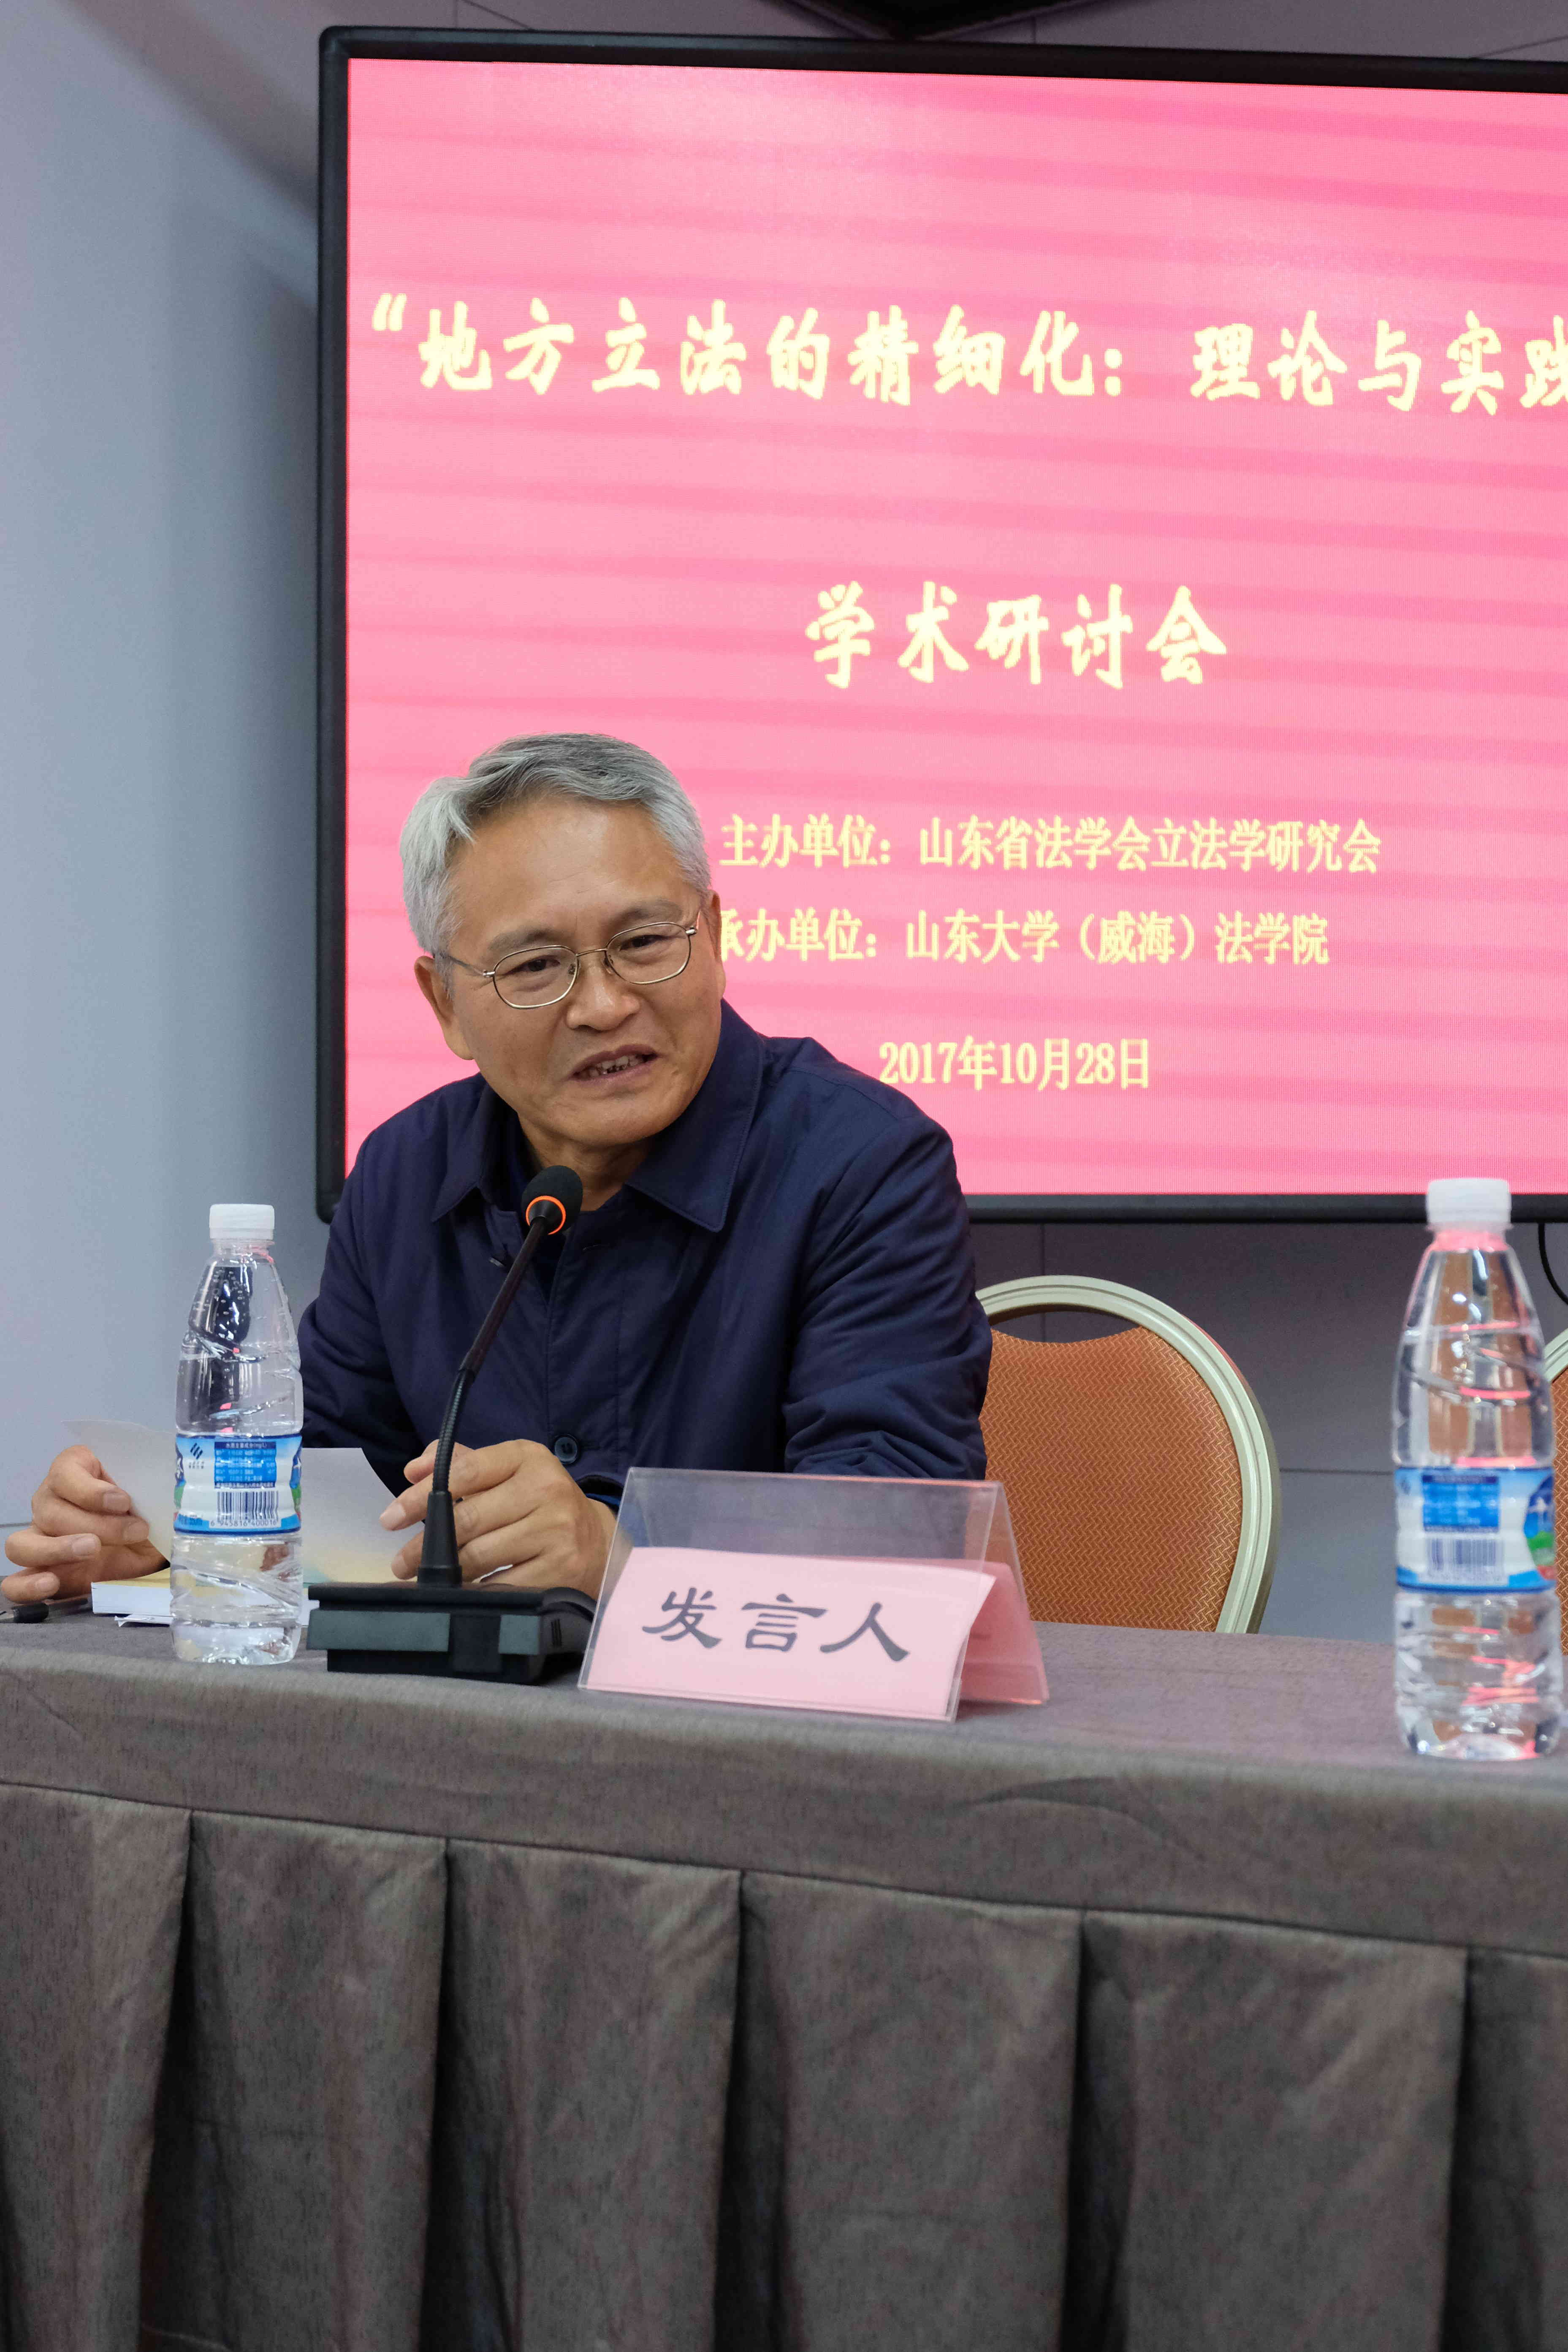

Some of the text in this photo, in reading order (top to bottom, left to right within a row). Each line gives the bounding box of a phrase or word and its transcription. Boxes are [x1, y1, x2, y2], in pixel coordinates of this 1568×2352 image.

[806, 581, 1227, 689] 学术研讨会
[879, 1036, 1148, 1091] 2017年10月28日
[642, 1587, 910, 1661] 发言人
